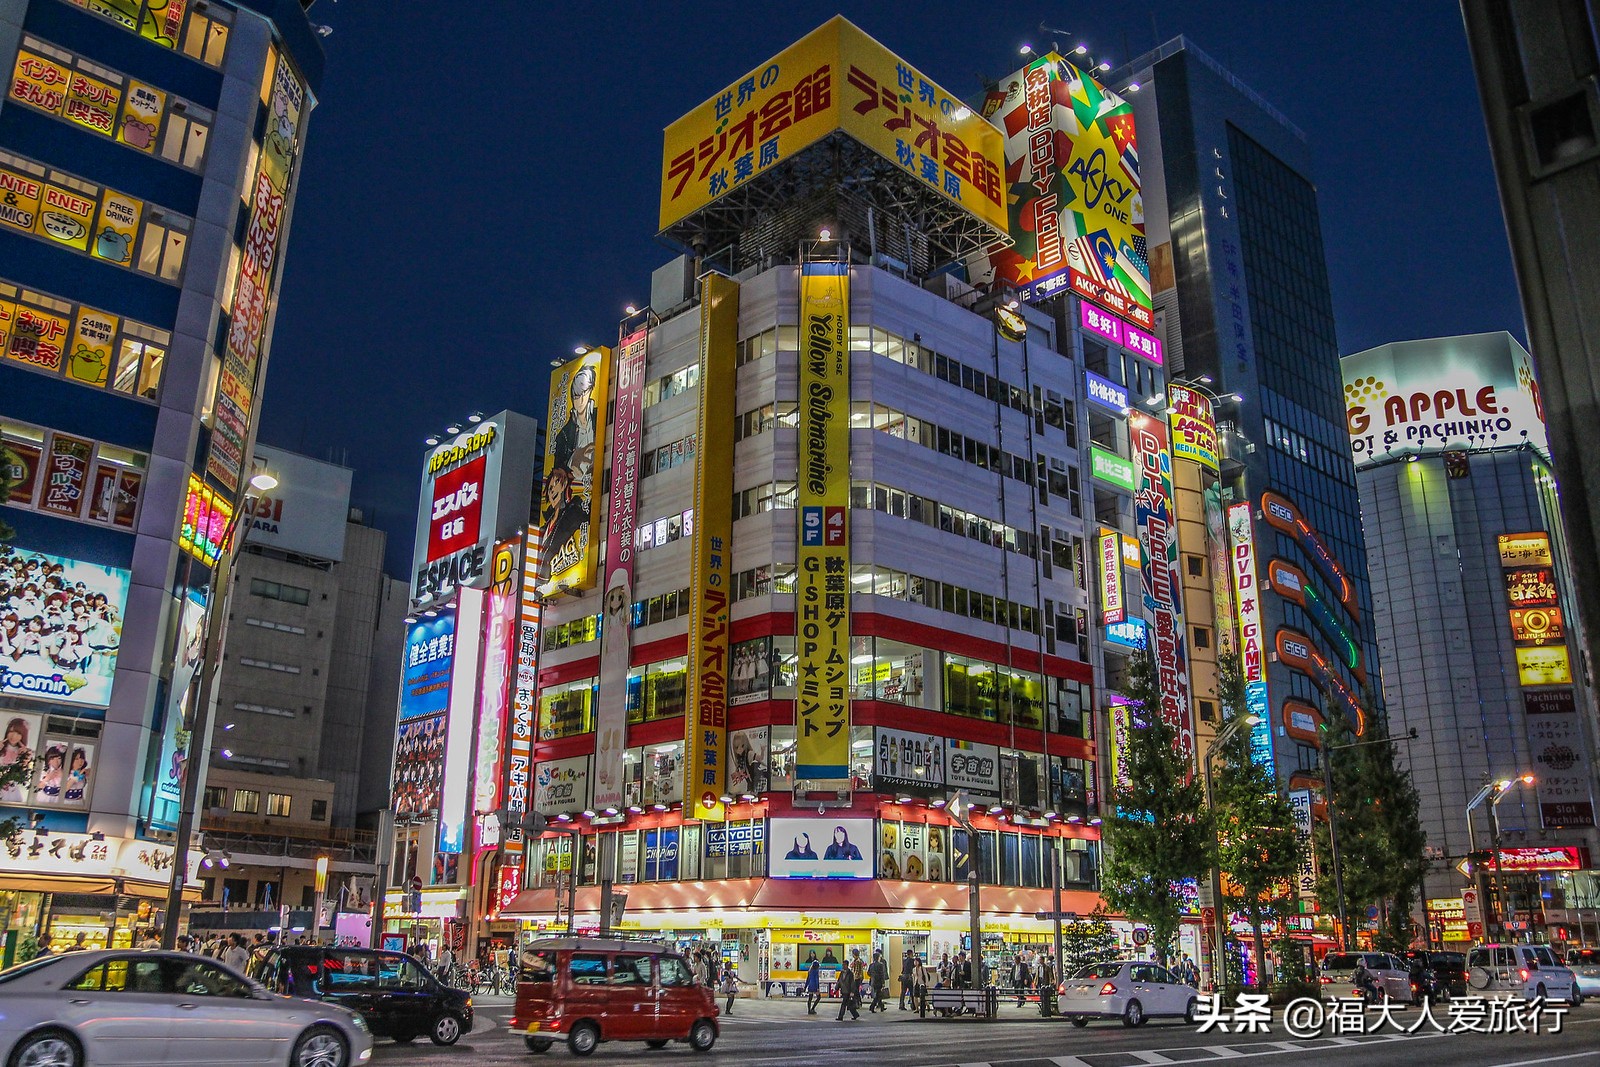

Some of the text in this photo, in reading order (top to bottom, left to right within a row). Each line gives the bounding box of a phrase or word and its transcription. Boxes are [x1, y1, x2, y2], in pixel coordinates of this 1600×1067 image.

[20, 57, 117, 109] インター ネット
[136, 88, 156, 104] 最新
[713, 64, 779, 120] 世界の
[895, 62, 955, 117] 世界の
[14, 81, 113, 131] まんが 喫茶
[1025, 66, 1052, 131] 免税店
[667, 64, 831, 202] ラジオ会館
[847, 64, 1002, 208] ラジオ会館
[708, 135, 780, 198] 秋葉原
[895, 137, 962, 201] 秋葉原
[1030, 129, 1055, 195] DUTY
[1068, 157, 1132, 204] AKKY
[4, 192, 18, 207] &
[46, 189, 91, 215] RNET
[109, 200, 133, 216] FREE
[1103, 203, 1129, 225] ONE
[45, 221, 74, 237] cafe
[105, 208, 134, 226] DRINK!
[1034, 194, 1062, 270] FREE
[1103, 291, 1124, 312] ONE
[16, 311, 66, 340] ネット
[80, 326, 110, 343] 営業中!
[82, 317, 112, 334] 24時間
[1088, 309, 1117, 338] 您好!
[10, 336, 60, 368] 喫茶
[806, 313, 835, 497] Yellow Submarine
[1383, 429, 1398, 445] &
[1406, 417, 1512, 440] PACHINKO
[427, 426, 497, 475] パチンコ&スロット
[1175, 443, 1197, 455] MEDIA
[1139, 430, 1164, 513] DUTY
[46, 502, 74, 513] AKIBA
[432, 481, 479, 521] エスパス
[804, 512, 821, 542] 5F
[827, 512, 844, 542] 4F
[710, 536, 722, 587] 世界の
[1147, 515, 1172, 605] FREE
[1502, 549, 1548, 559] 北海道
[416, 546, 486, 599] ESPACE
[699, 588, 728, 729] ラジオ会館
[825, 556, 846, 738] 秋葉原ゲームショップ
[0, 672, 72, 696] reamin
[1526, 692, 1571, 701] Pachinko
[1539, 702, 1559, 712] Slot
[758, 731, 767, 740] 6F
[703, 730, 718, 786] 秋葉原
[880, 744, 931, 767] azone
[951, 753, 994, 779] 宇宙船
[971, 777, 994, 785] FIGURES
[1545, 815, 1592, 825] Pachinko
[1556, 805, 1577, 814] Slot
[92, 844, 107, 854] 24
[710, 828, 763, 842] KAYODO
[904, 837, 919, 850] 6F
